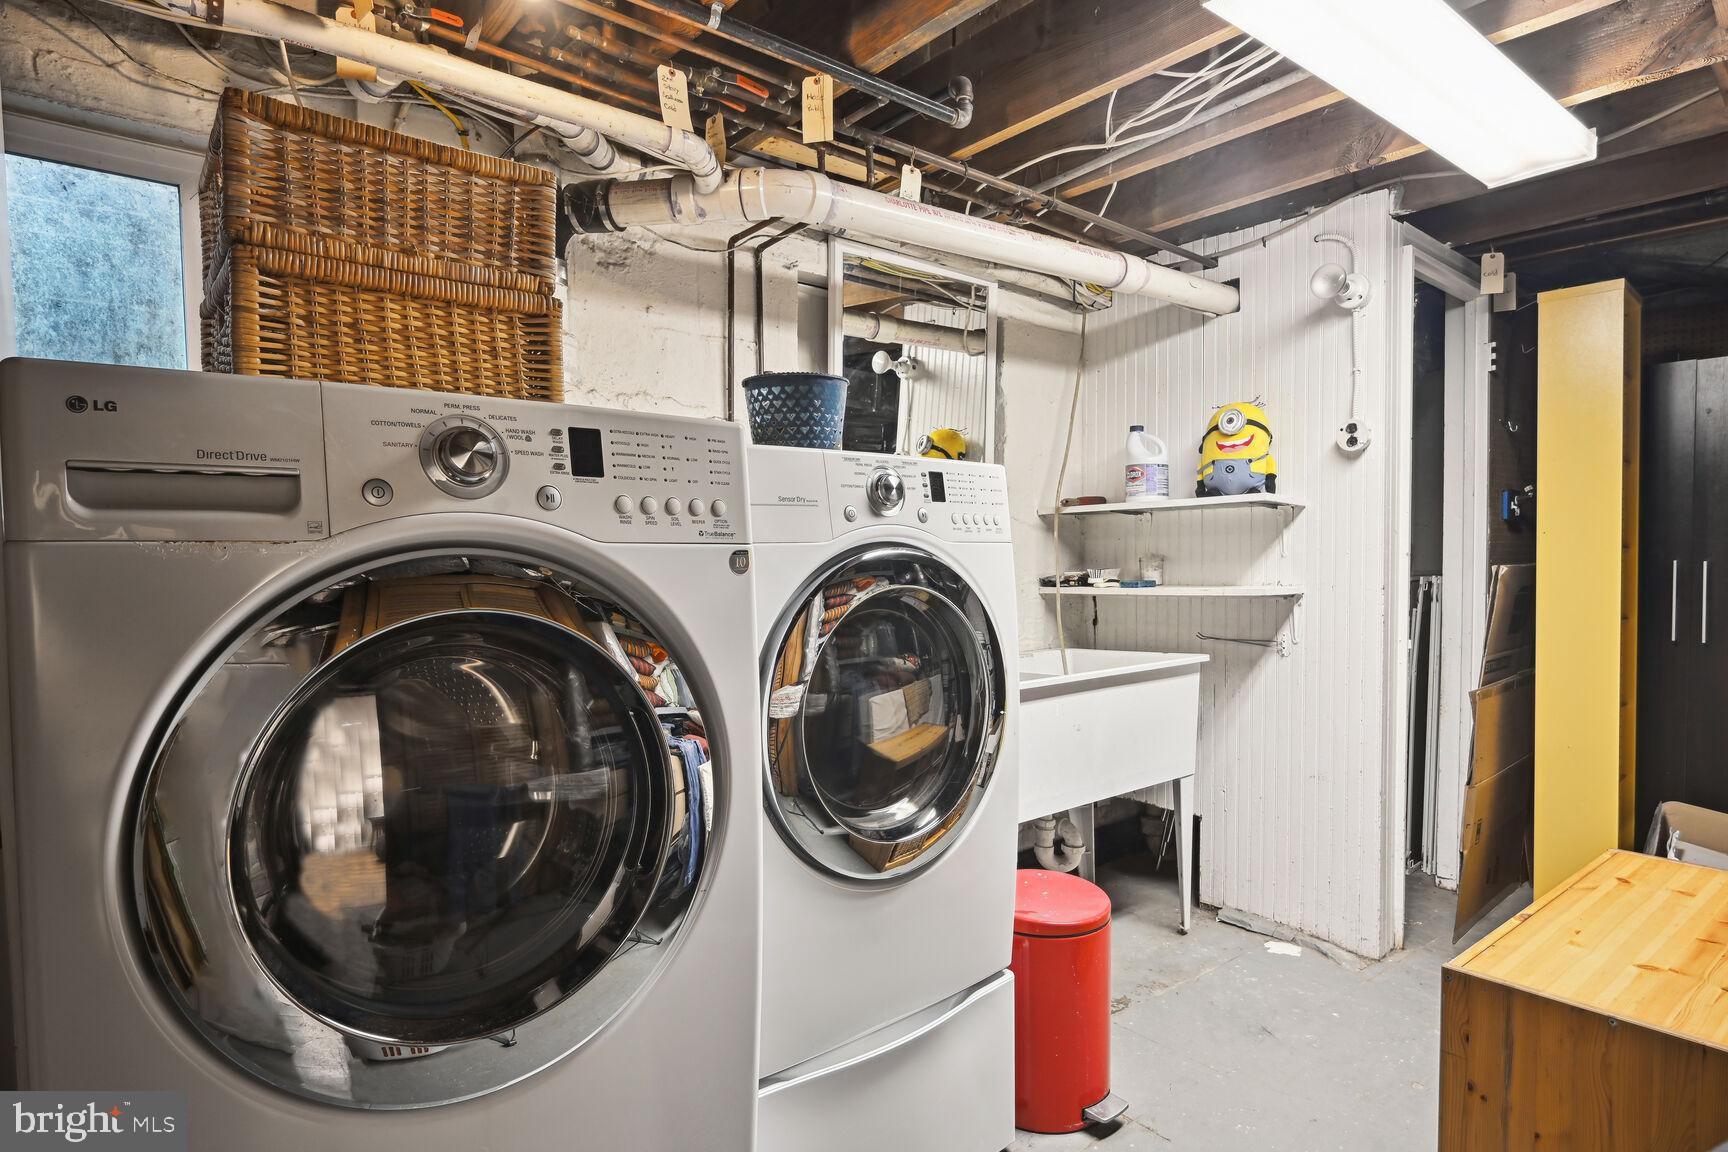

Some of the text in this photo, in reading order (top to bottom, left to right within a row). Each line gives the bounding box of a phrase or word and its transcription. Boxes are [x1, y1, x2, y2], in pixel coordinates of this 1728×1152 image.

[93, 400, 117, 412] LG
[462, 404, 481, 412] PRESS
[410, 408, 437, 416] NORMAL
[371, 420, 422, 429] COTTON/TOWELS
